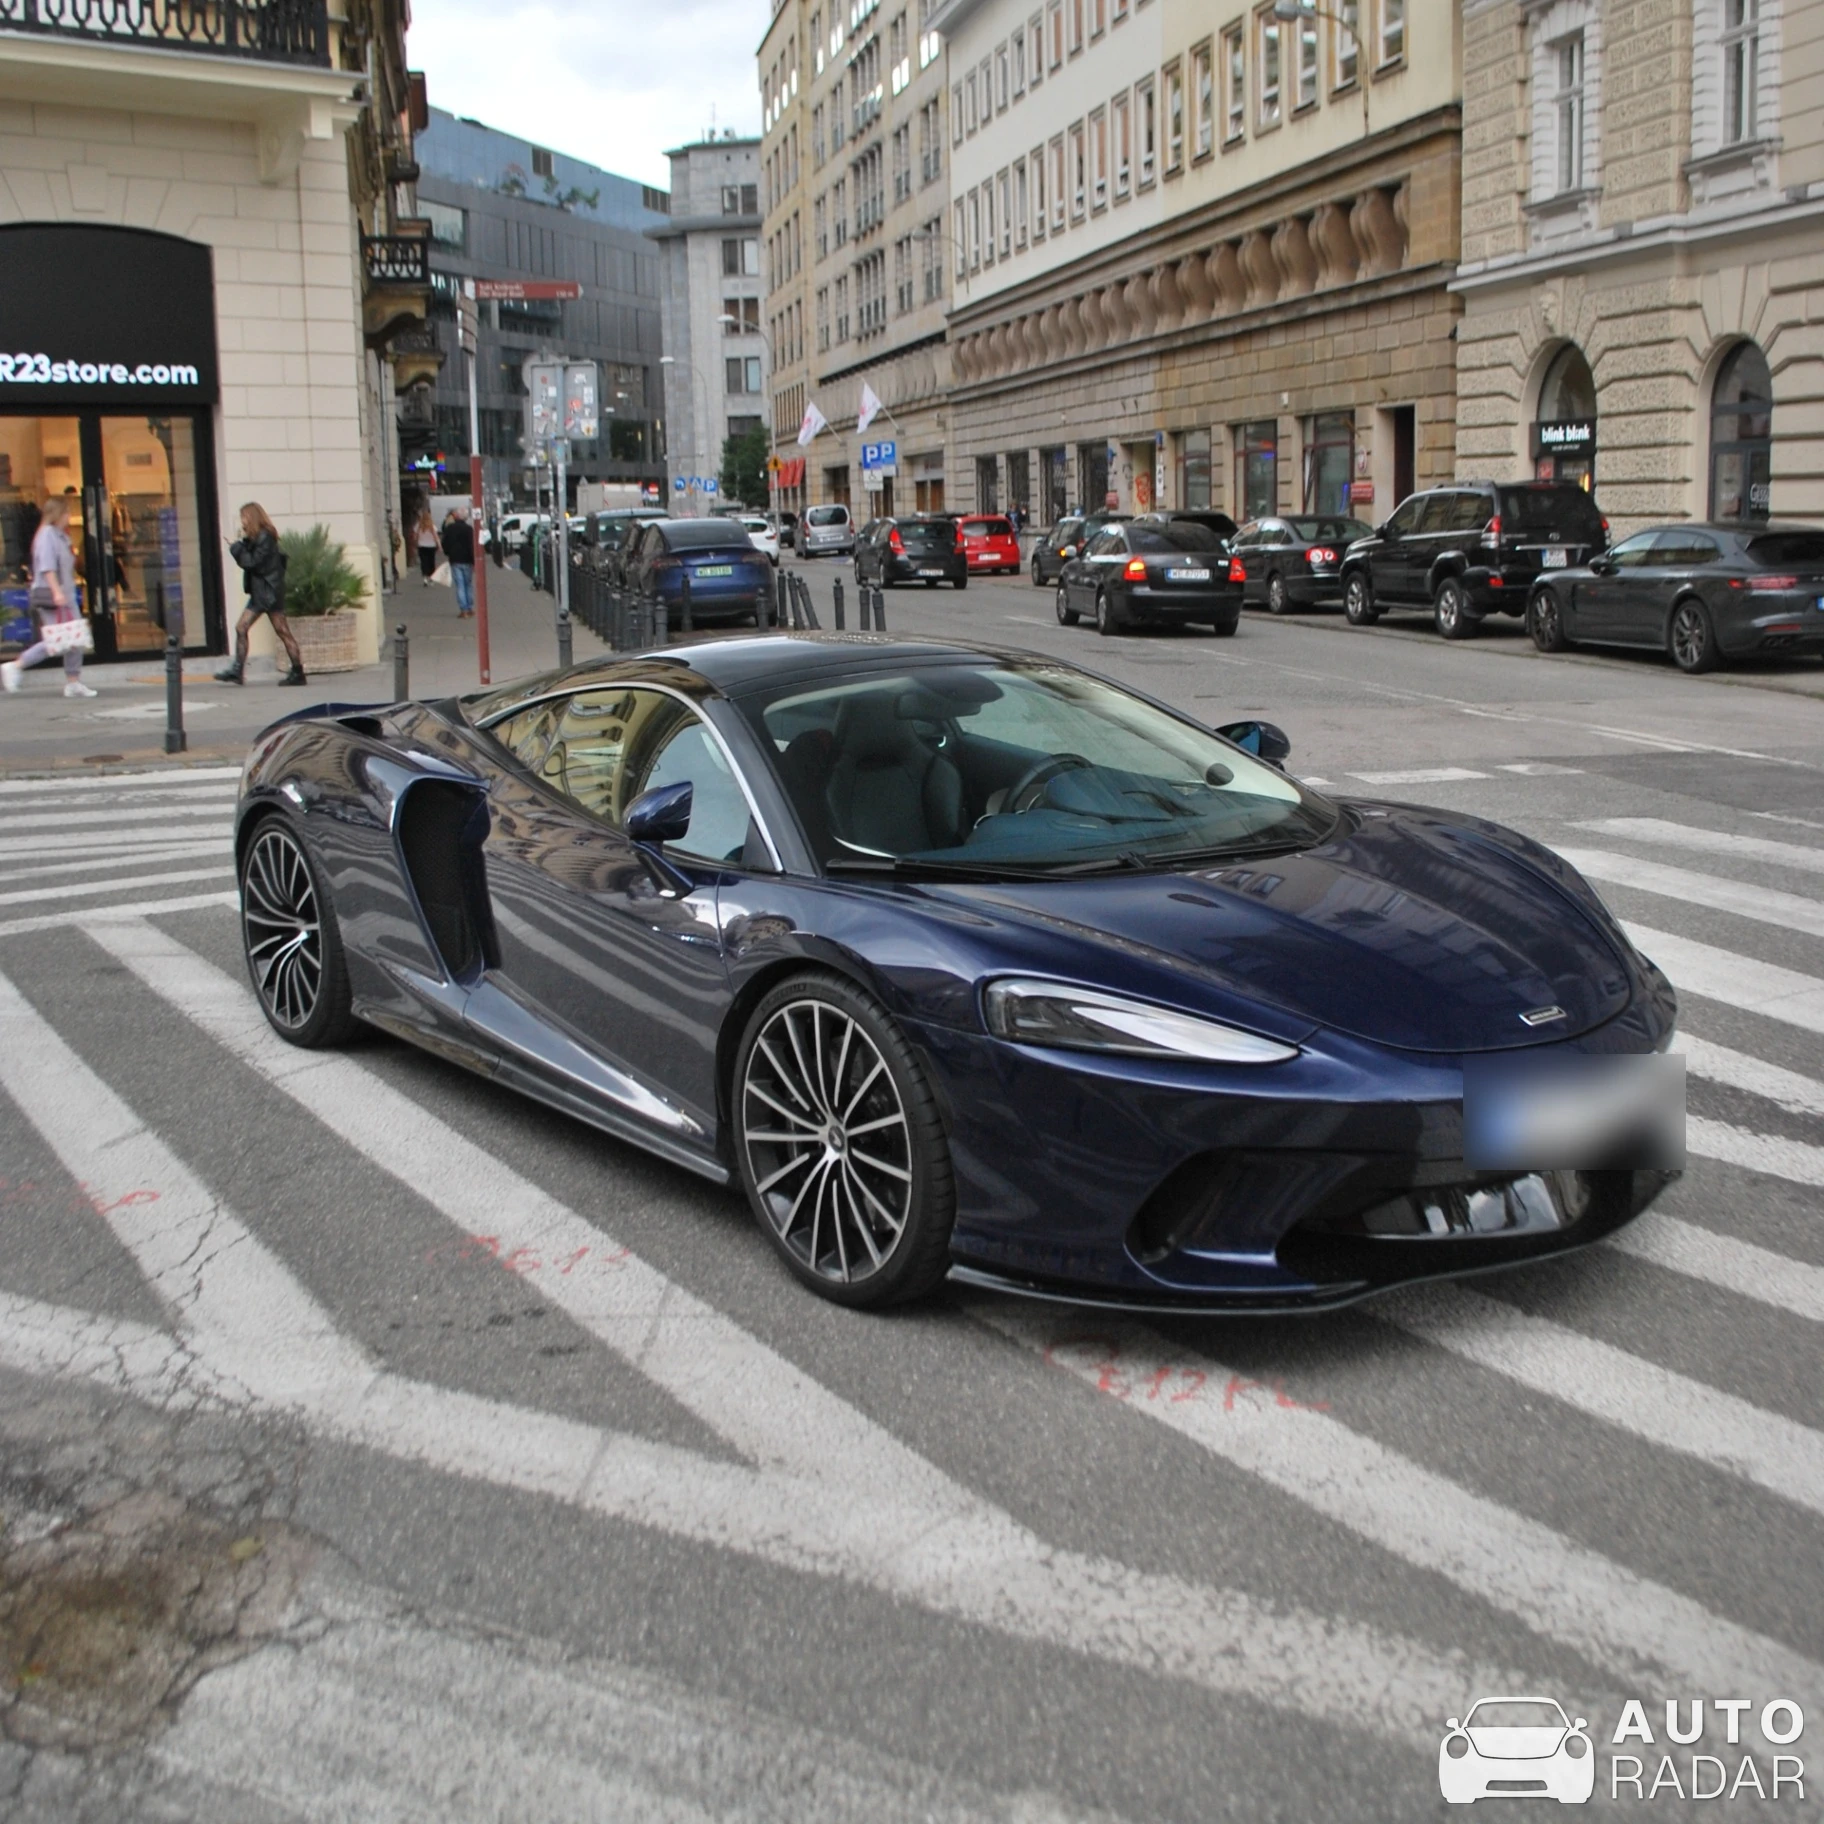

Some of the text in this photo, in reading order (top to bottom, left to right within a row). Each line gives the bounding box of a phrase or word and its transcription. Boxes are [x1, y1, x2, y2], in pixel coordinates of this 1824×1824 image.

[1541, 425, 1565, 443] blink
[866, 446, 879, 463] P
[881, 443, 893, 459] P
